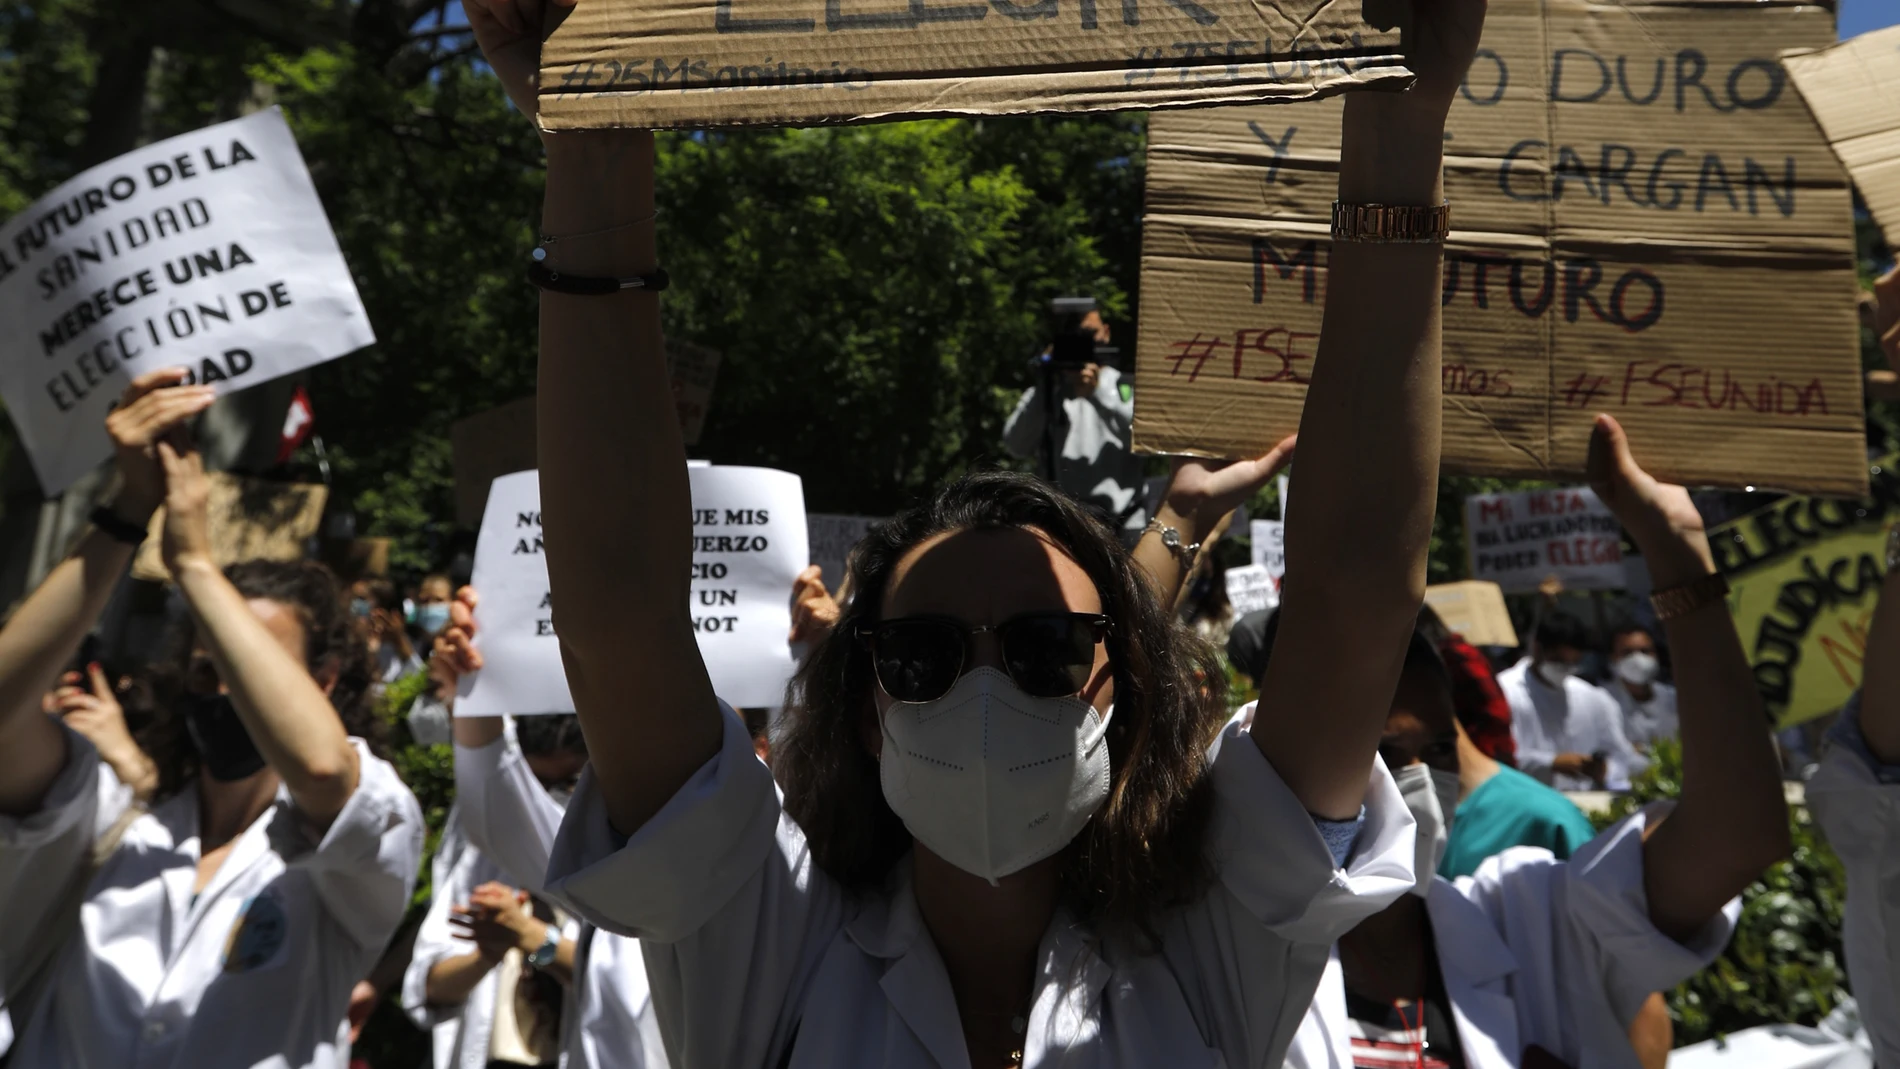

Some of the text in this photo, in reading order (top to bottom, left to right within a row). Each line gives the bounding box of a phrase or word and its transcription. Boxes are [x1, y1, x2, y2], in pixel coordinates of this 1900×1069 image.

[1549, 48, 1786, 112] DURO
[13, 174, 137, 262] FUTURO
[146, 152, 197, 189] DE
[203, 140, 256, 172] LA
[1248, 120, 1297, 184] Y
[1500, 139, 1796, 217] CARGAN
[37, 197, 211, 300] SANIDAD
[1252, 238, 1329, 305] M
[37, 242, 256, 357] MERECE UNA
[47, 281, 293, 409] ELECCIÓN DE
[725, 509, 769, 525] MIS
[700, 590, 737, 606] UN
